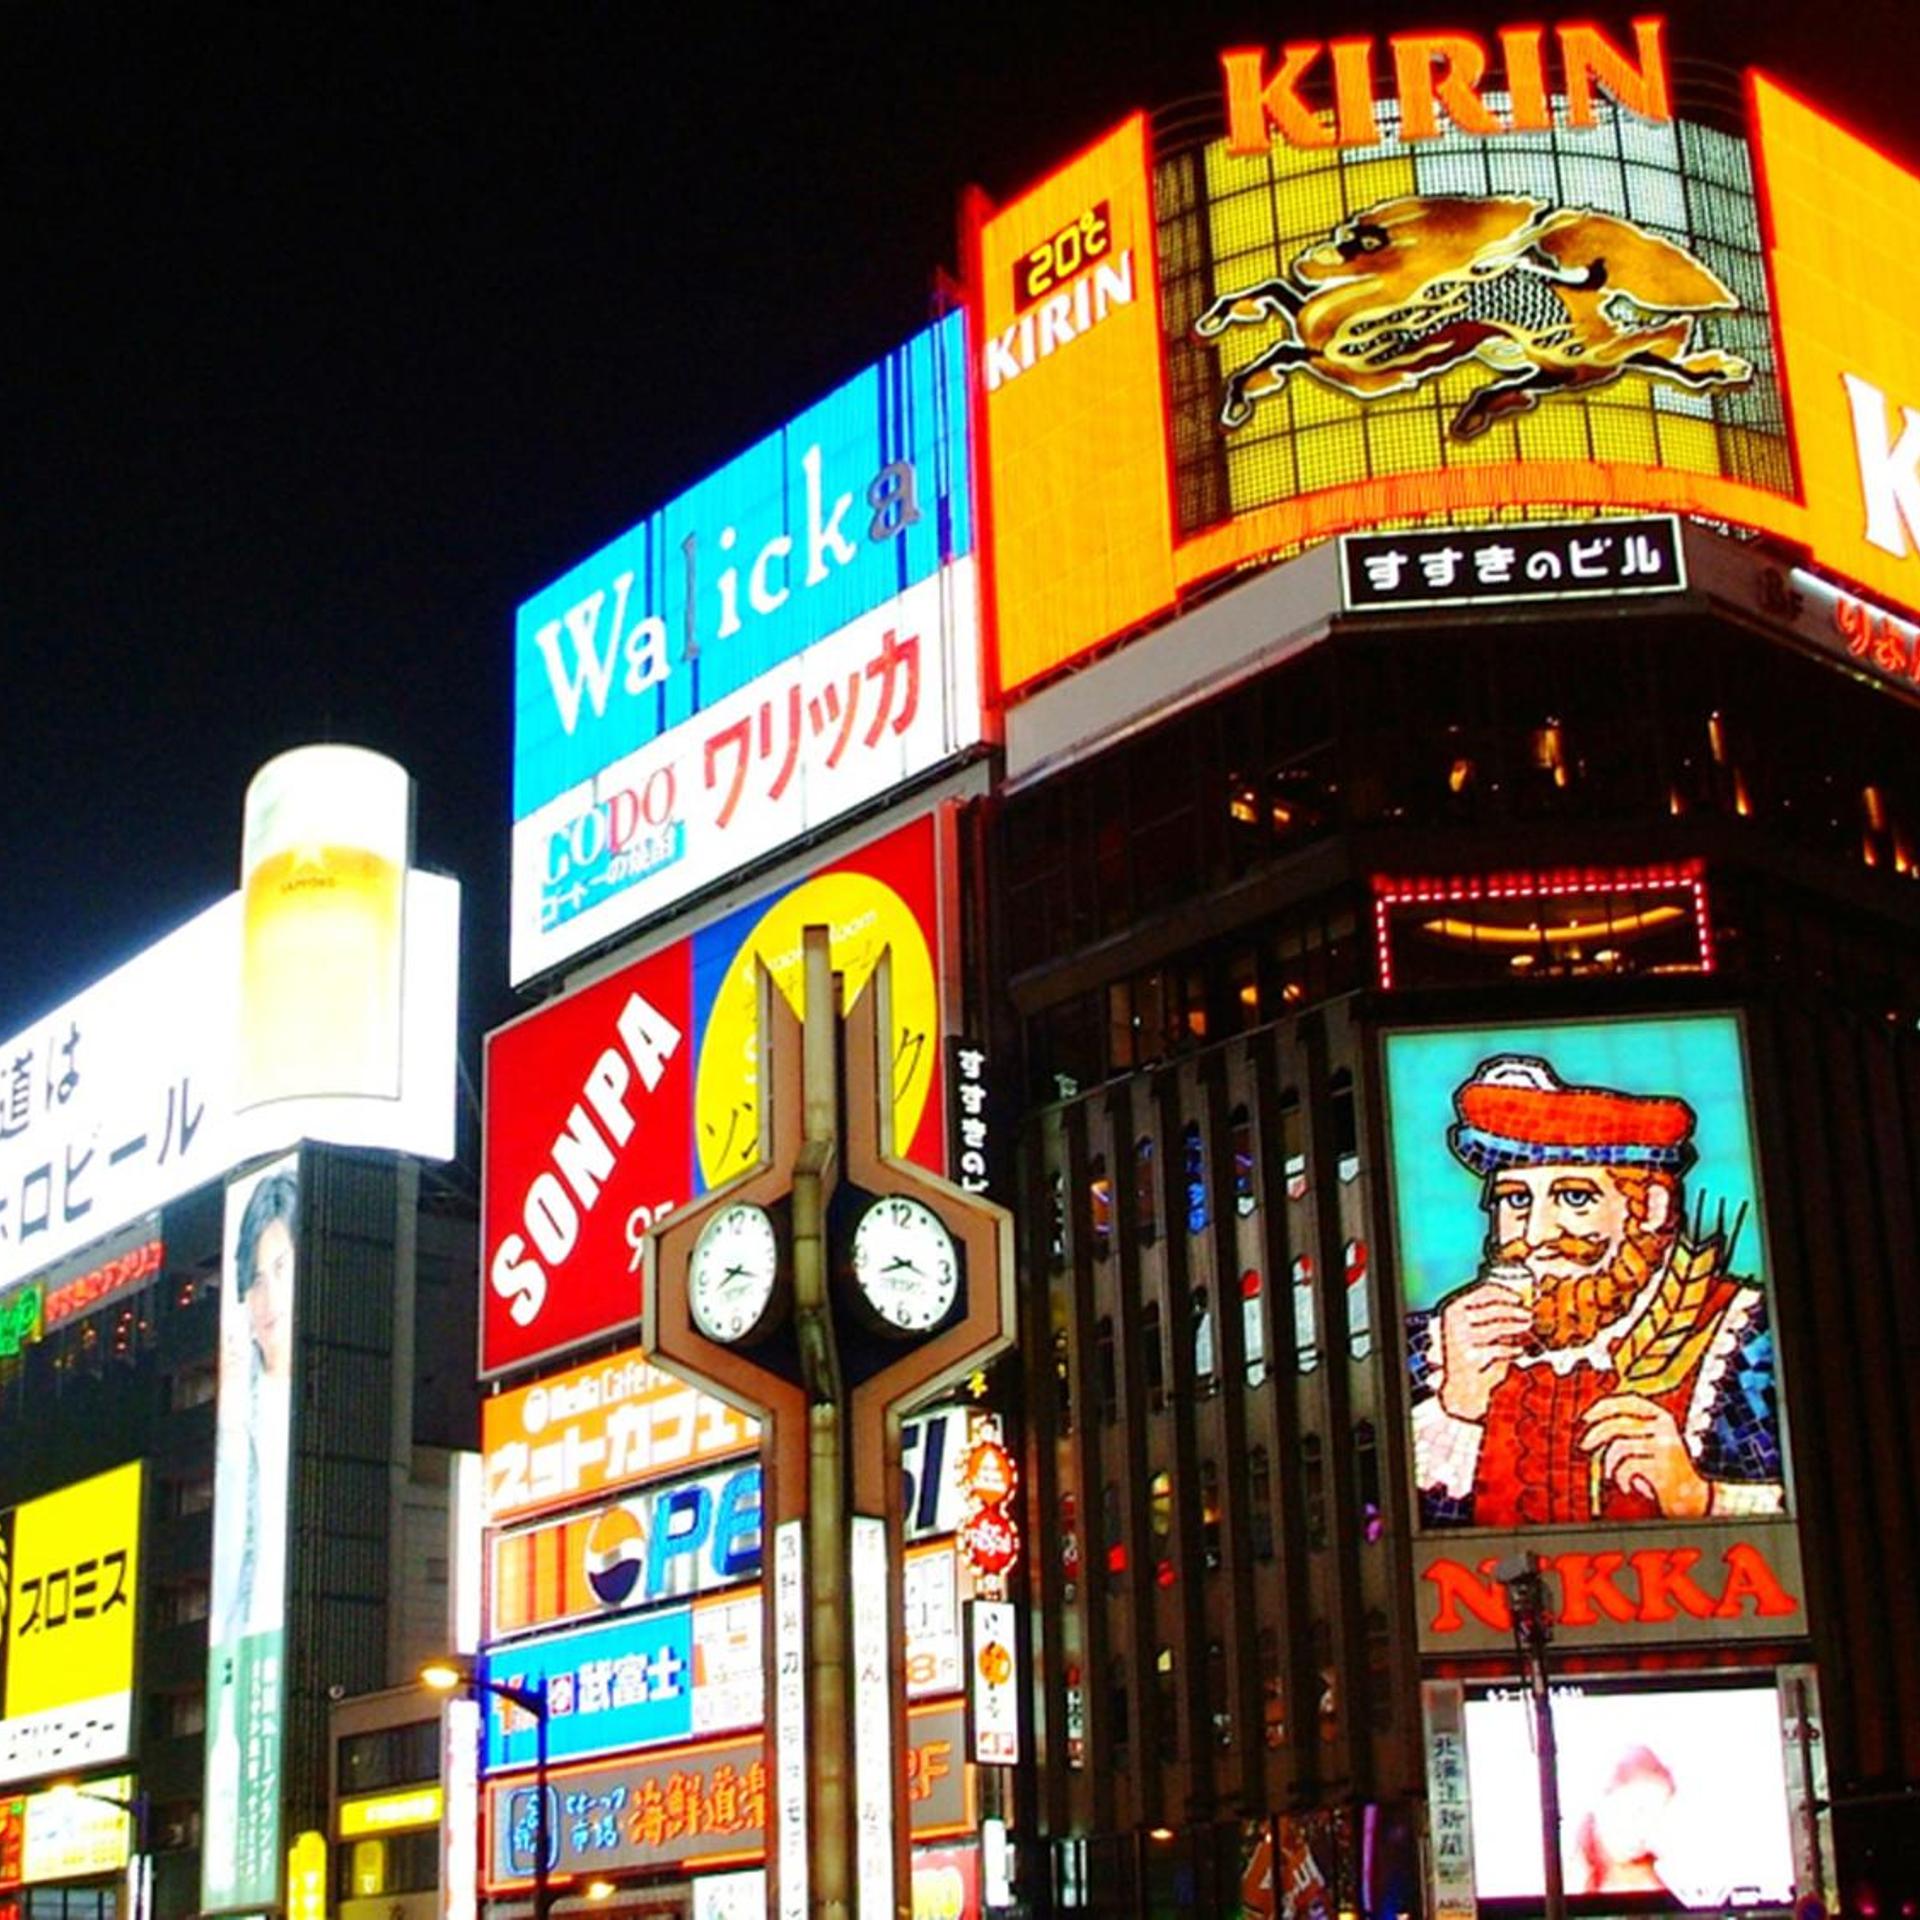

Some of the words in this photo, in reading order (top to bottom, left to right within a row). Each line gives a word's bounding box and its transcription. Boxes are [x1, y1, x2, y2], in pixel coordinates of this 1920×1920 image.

[1222, 17, 1671, 156] KIRIN
[985, 249, 1134, 393] KIRIN
[534, 444, 921, 736] Walicka
[1363, 534, 1661, 591] すすきのビル
[703, 628, 920, 829] ワリッカ
[0, 1077, 205, 1244] ロビール
[491, 991, 682, 1327] SONPA
[890, 1202, 913, 1231] 12
[938, 1260, 953, 1286] 3
[487, 1390, 762, 1510] ネットカフェ
[1422, 1541, 1799, 1634] NKKA
